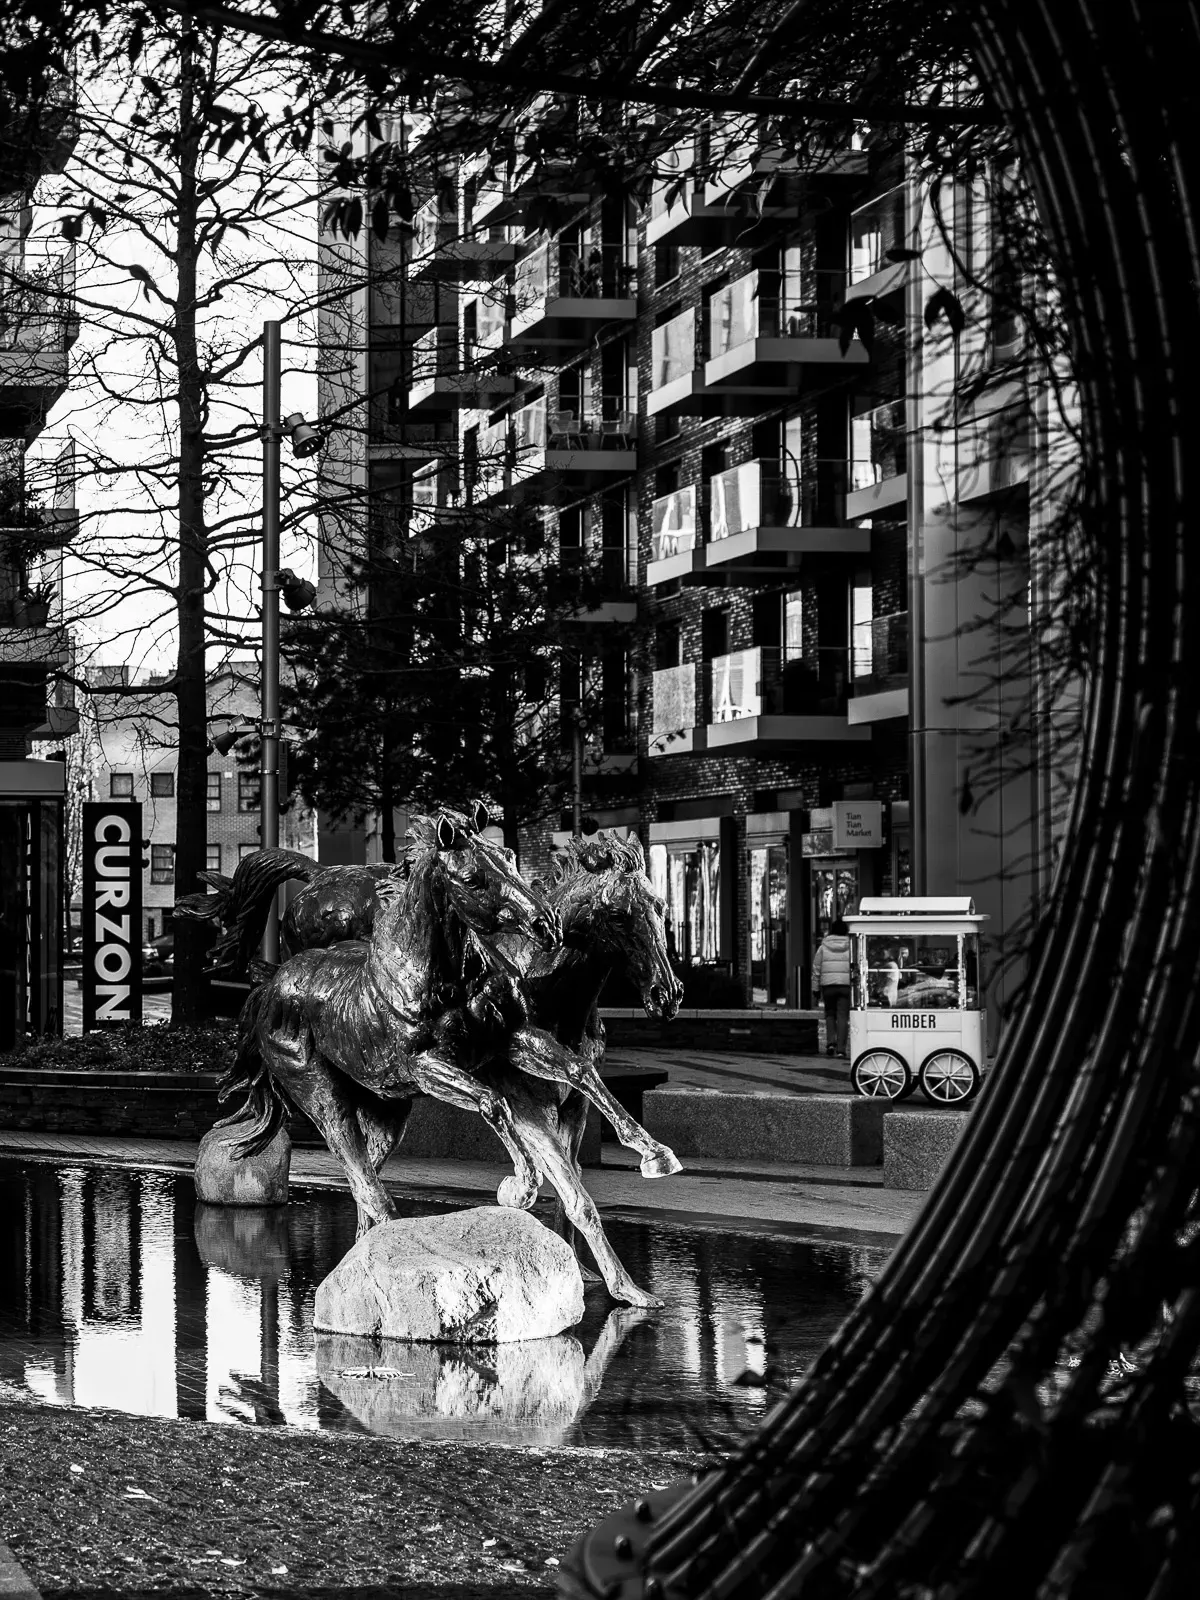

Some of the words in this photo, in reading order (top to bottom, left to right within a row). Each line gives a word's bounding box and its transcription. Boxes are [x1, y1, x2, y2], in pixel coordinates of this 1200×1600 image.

[846, 829, 872, 837] Market
[94, 814, 132, 1021] CURZON
[891, 1014, 936, 1029] AMBER
